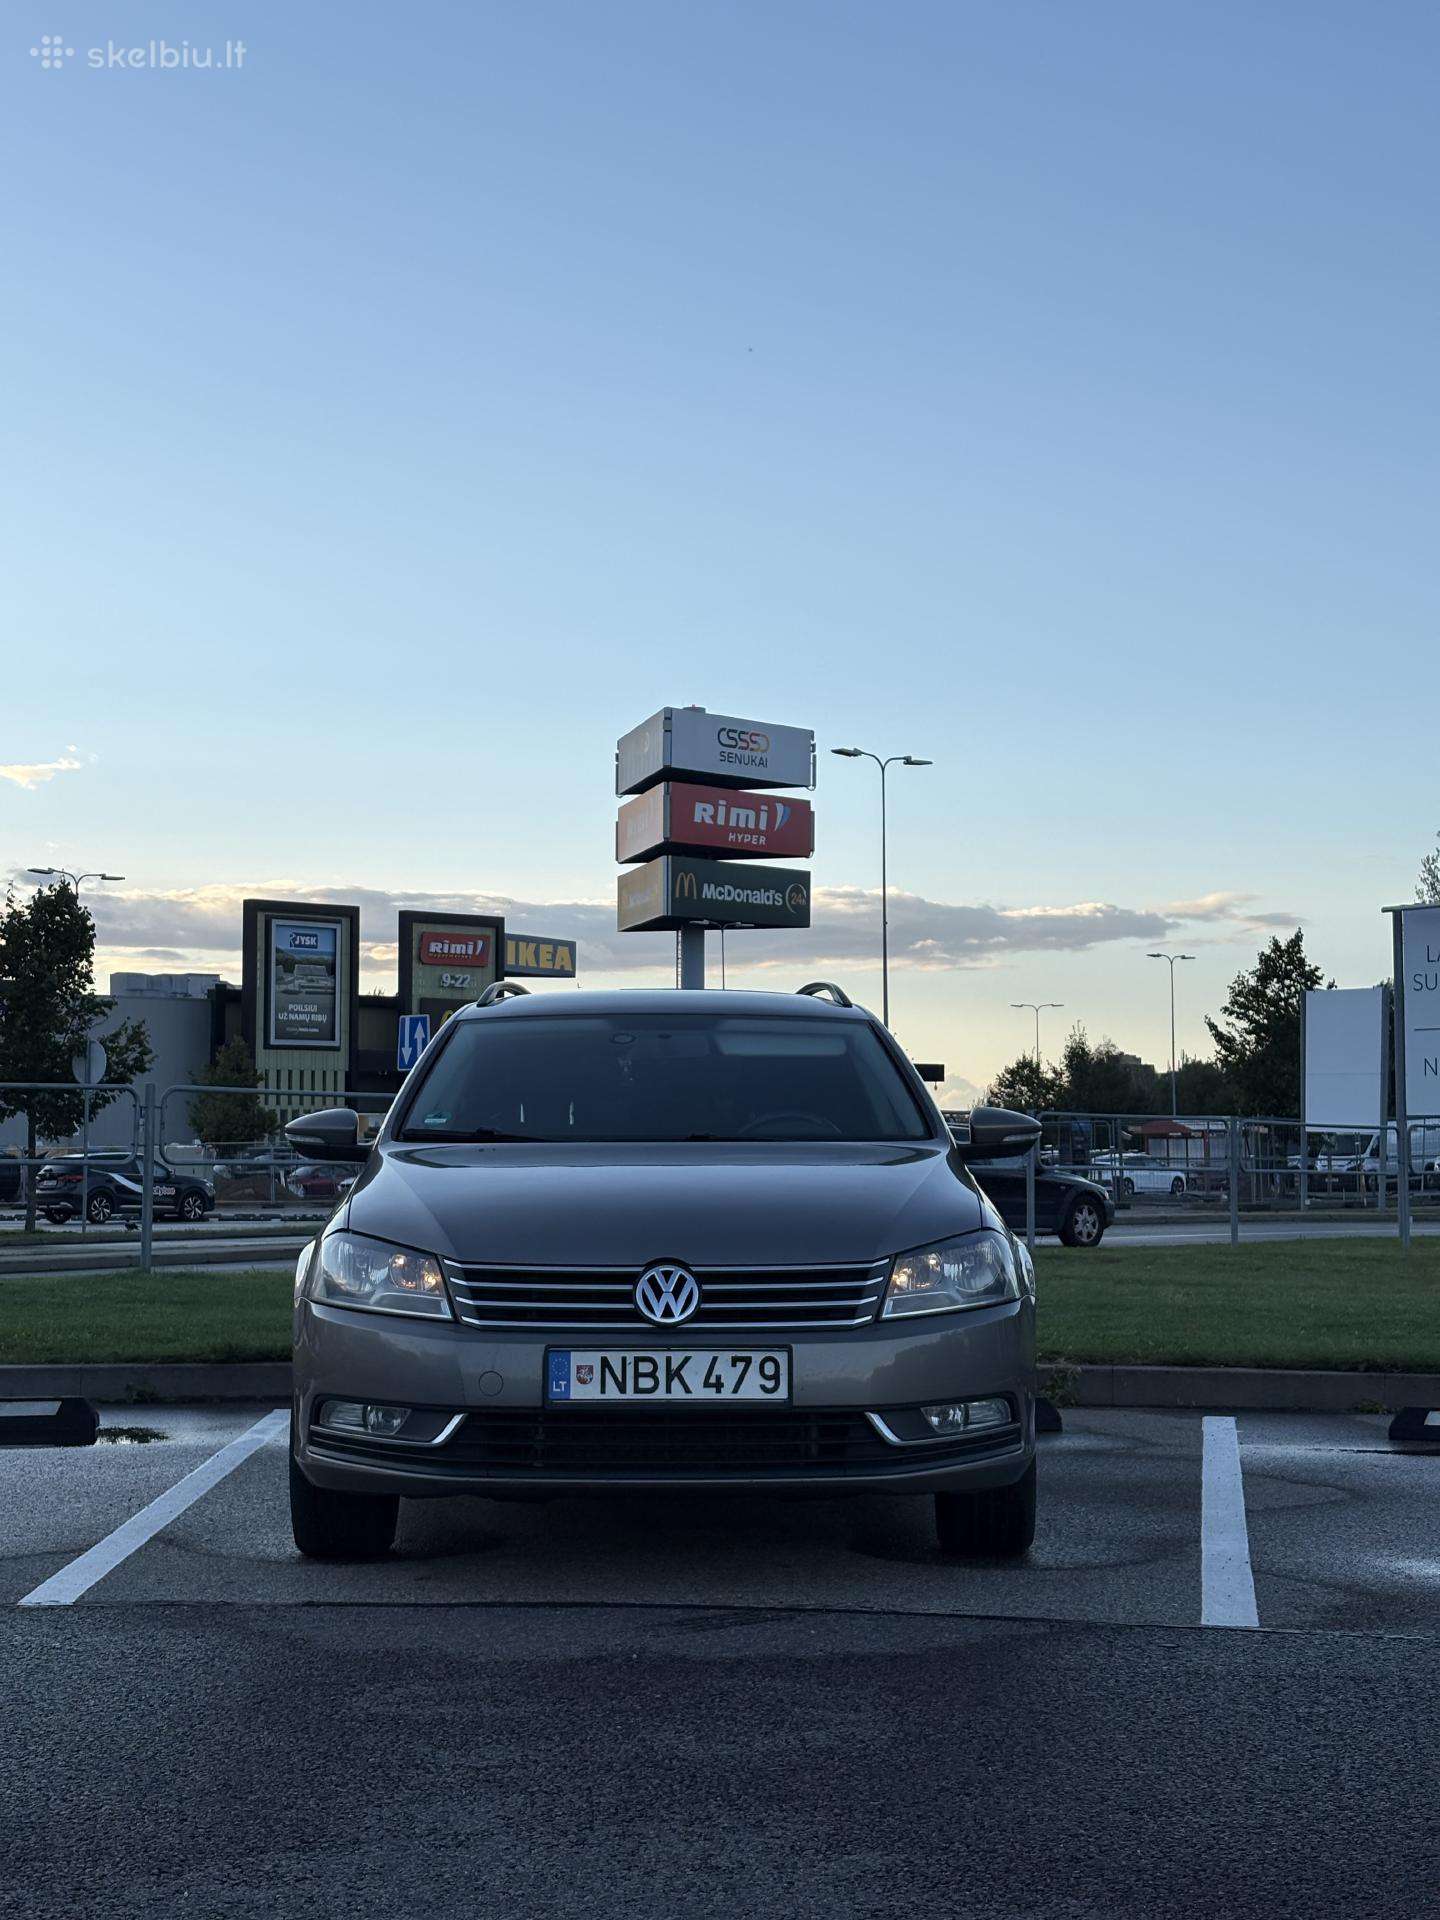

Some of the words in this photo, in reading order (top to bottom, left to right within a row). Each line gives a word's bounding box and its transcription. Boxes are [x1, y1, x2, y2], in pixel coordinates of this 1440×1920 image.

[719, 750, 768, 769] SENUKAI
[693, 799, 769, 831] Rimi
[728, 832, 767, 846] HYPER
[702, 882, 783, 907] McDonald's
[295, 936, 316, 946] JYSK
[429, 939, 474, 955] Rimi
[507, 940, 573, 971] IKEA
[441, 972, 471, 988] 9-22
[552, 1380, 567, 1392] LT
[600, 1355, 692, 1395] NBK
[702, 1355, 781, 1395] 479
